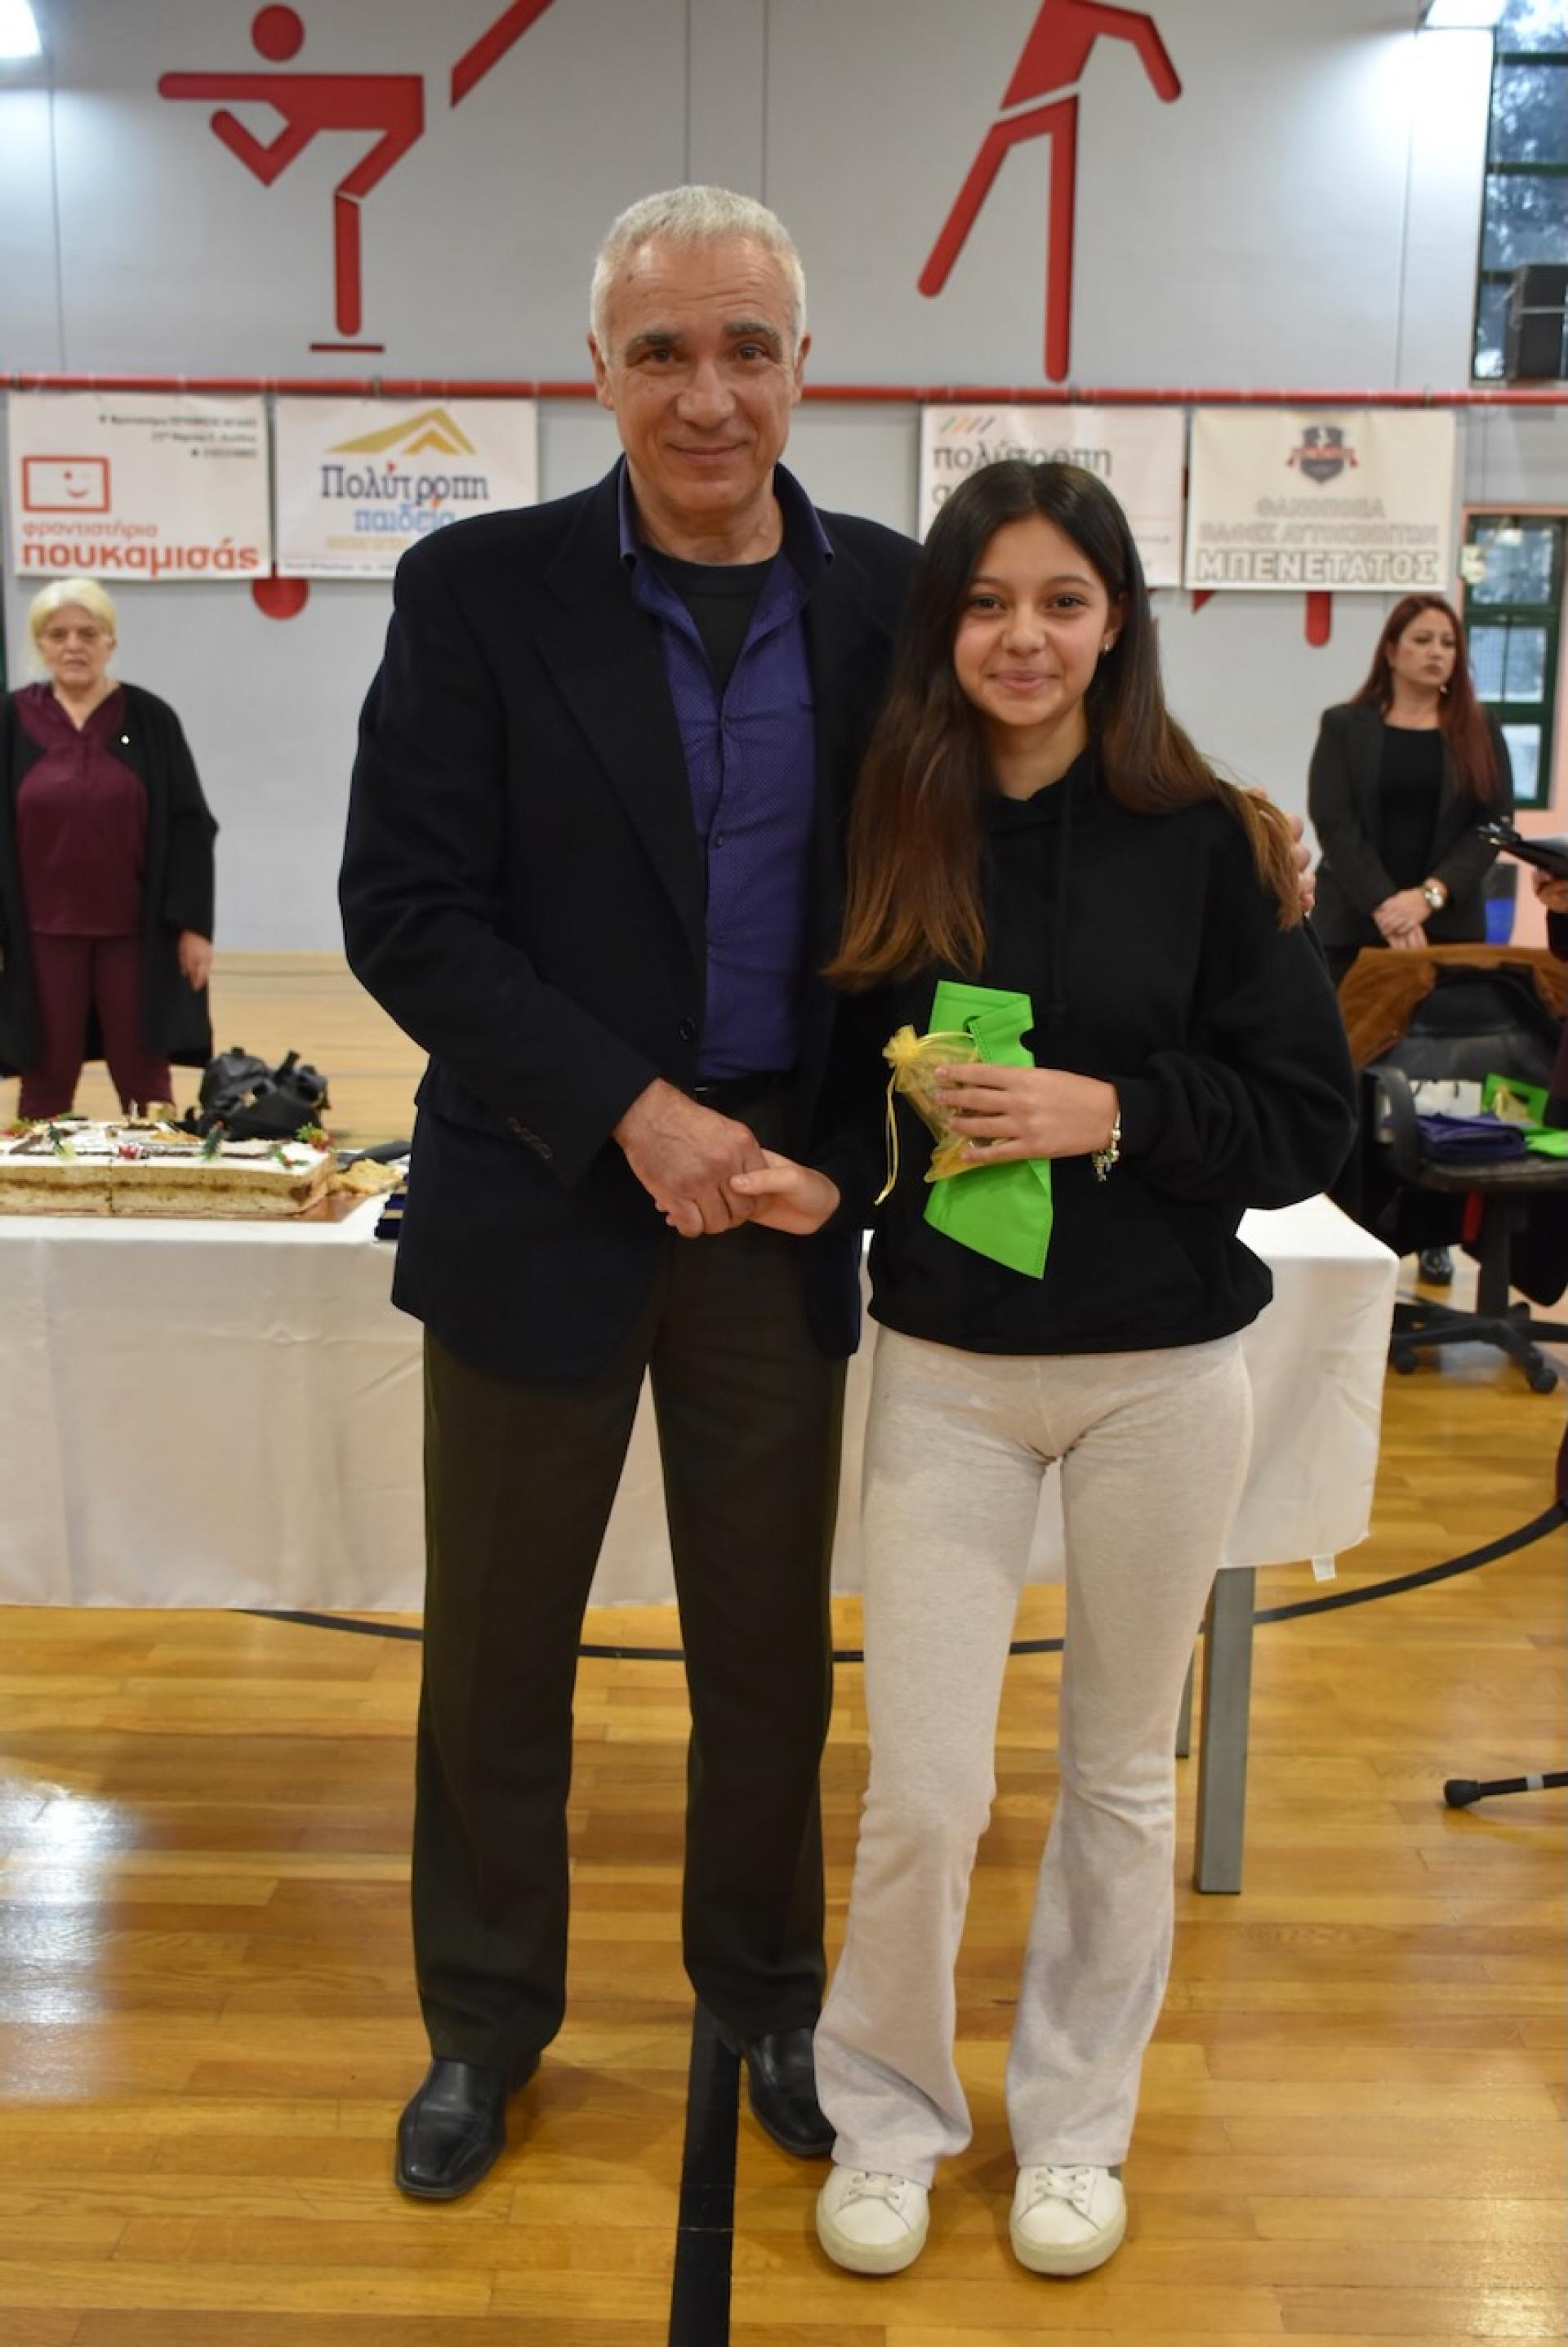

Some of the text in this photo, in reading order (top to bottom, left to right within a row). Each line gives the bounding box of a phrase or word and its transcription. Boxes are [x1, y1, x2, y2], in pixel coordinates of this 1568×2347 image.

[321, 461, 490, 505] Πολύτροπη
[22, 536, 260, 579] πουκαμισάς
[1196, 549, 1438, 584] ΜΠΕΝΕΤΑΤΟΣ
